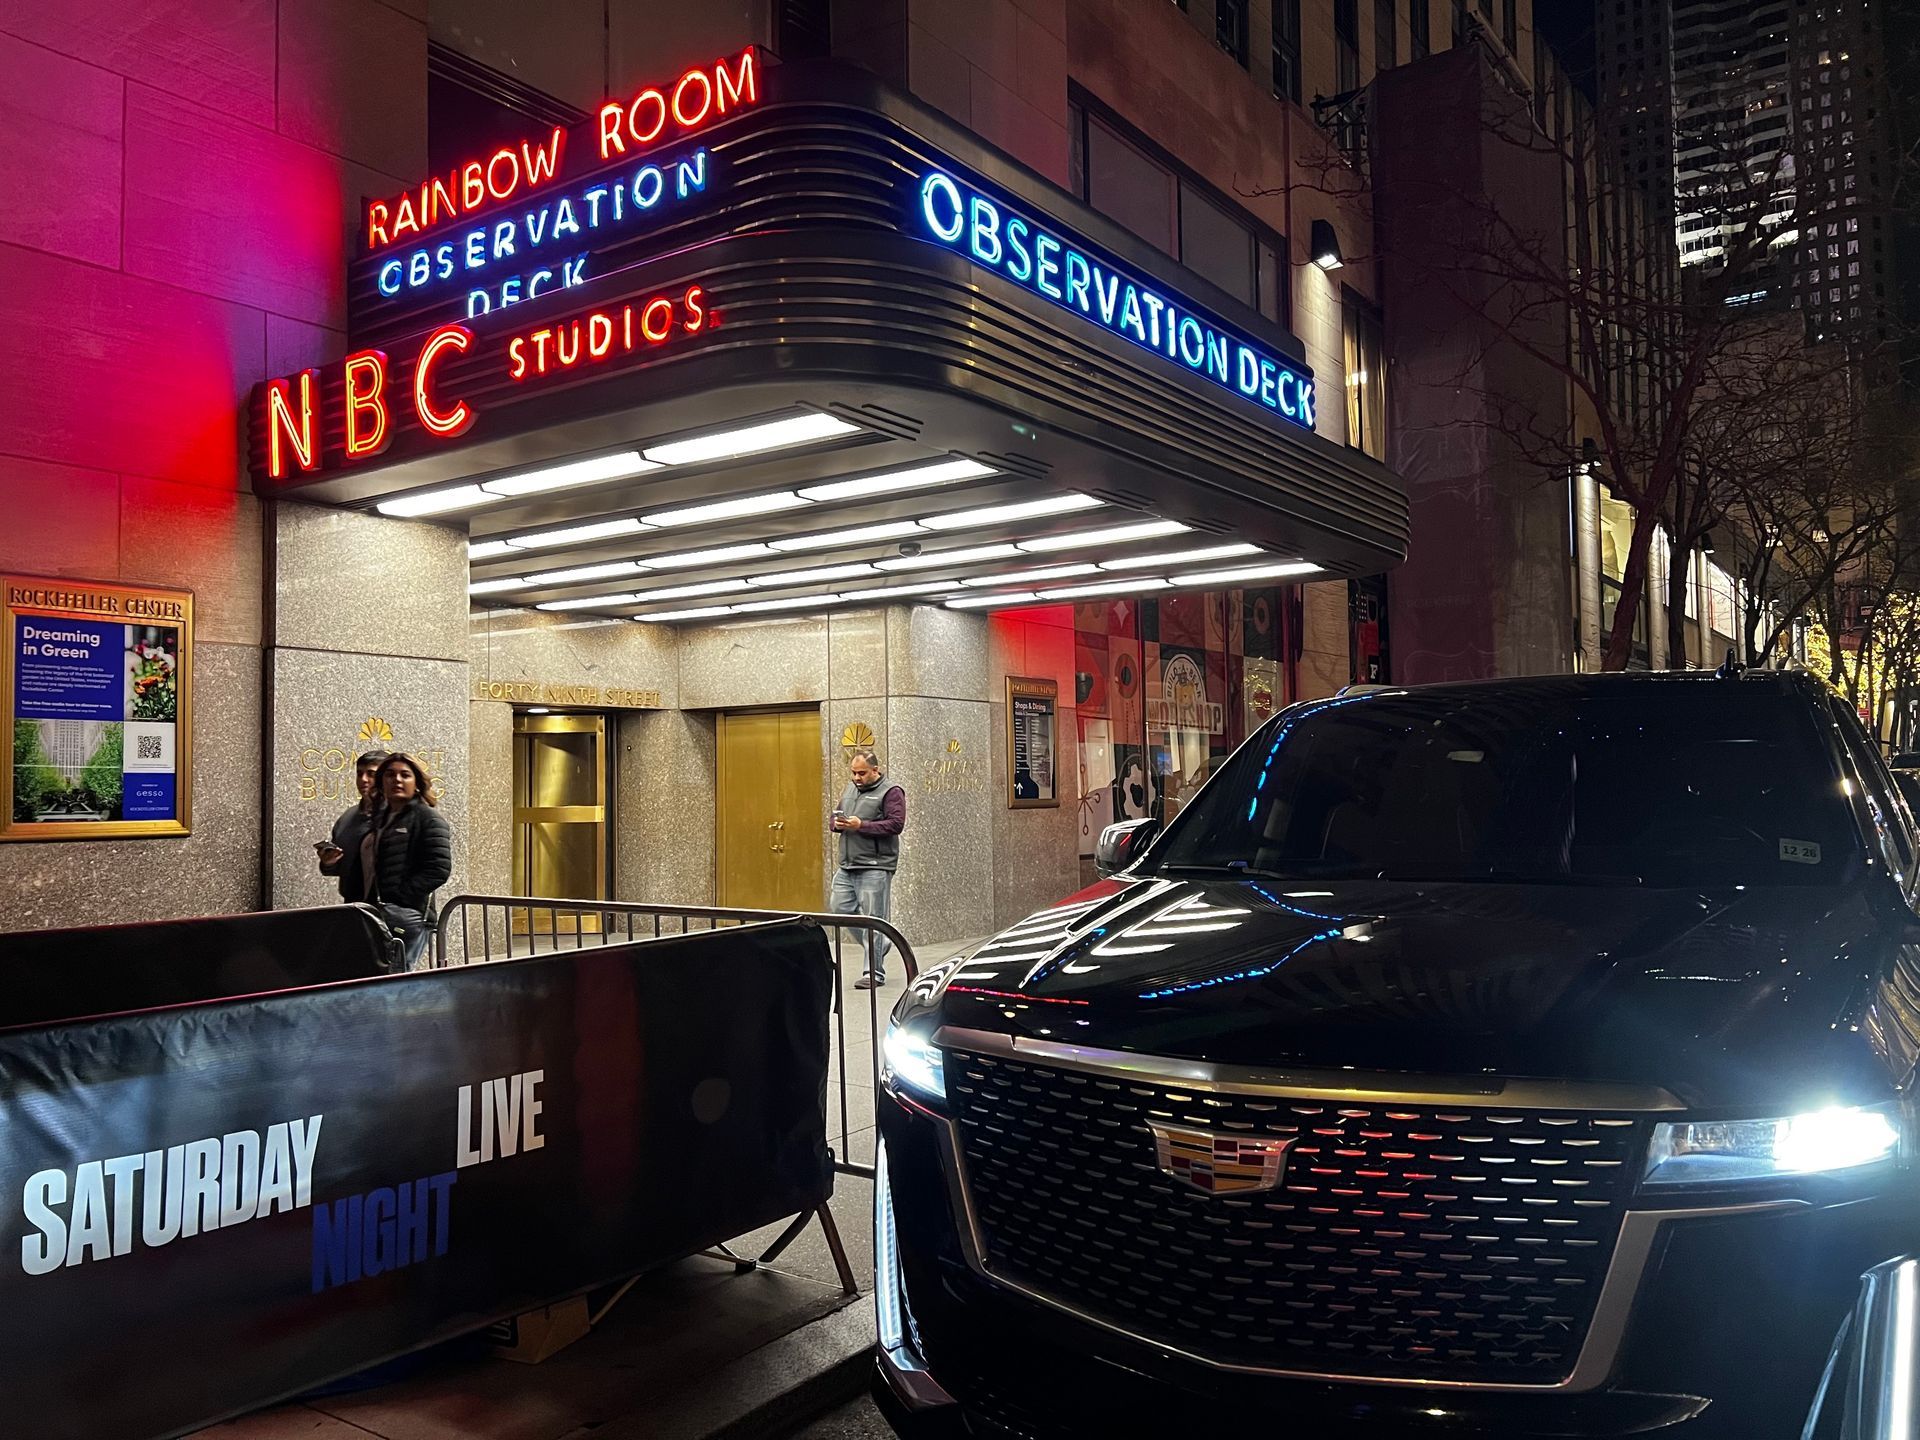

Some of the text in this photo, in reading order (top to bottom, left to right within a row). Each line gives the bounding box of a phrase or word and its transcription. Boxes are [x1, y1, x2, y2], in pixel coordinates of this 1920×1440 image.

[369, 44, 757, 249] RAINBOW ROOM
[379, 146, 707, 297] OBSERVATION
[922, 173, 1315, 427] OBSERVATION DECK
[268, 285, 704, 478] NBC STUDIOS
[10, 587, 182, 618] ROCKEFELLER CENTER
[23, 626, 100, 647] Dreaming
[23, 643, 89, 659] in Green
[480, 682, 661, 706] FORTY NINTH STREET
[1783, 845, 1798, 856] 12
[456, 1069, 545, 1168] LIVE
[21, 1114, 323, 1276] SATURDAY
[311, 1170, 458, 1294] NIGHT
